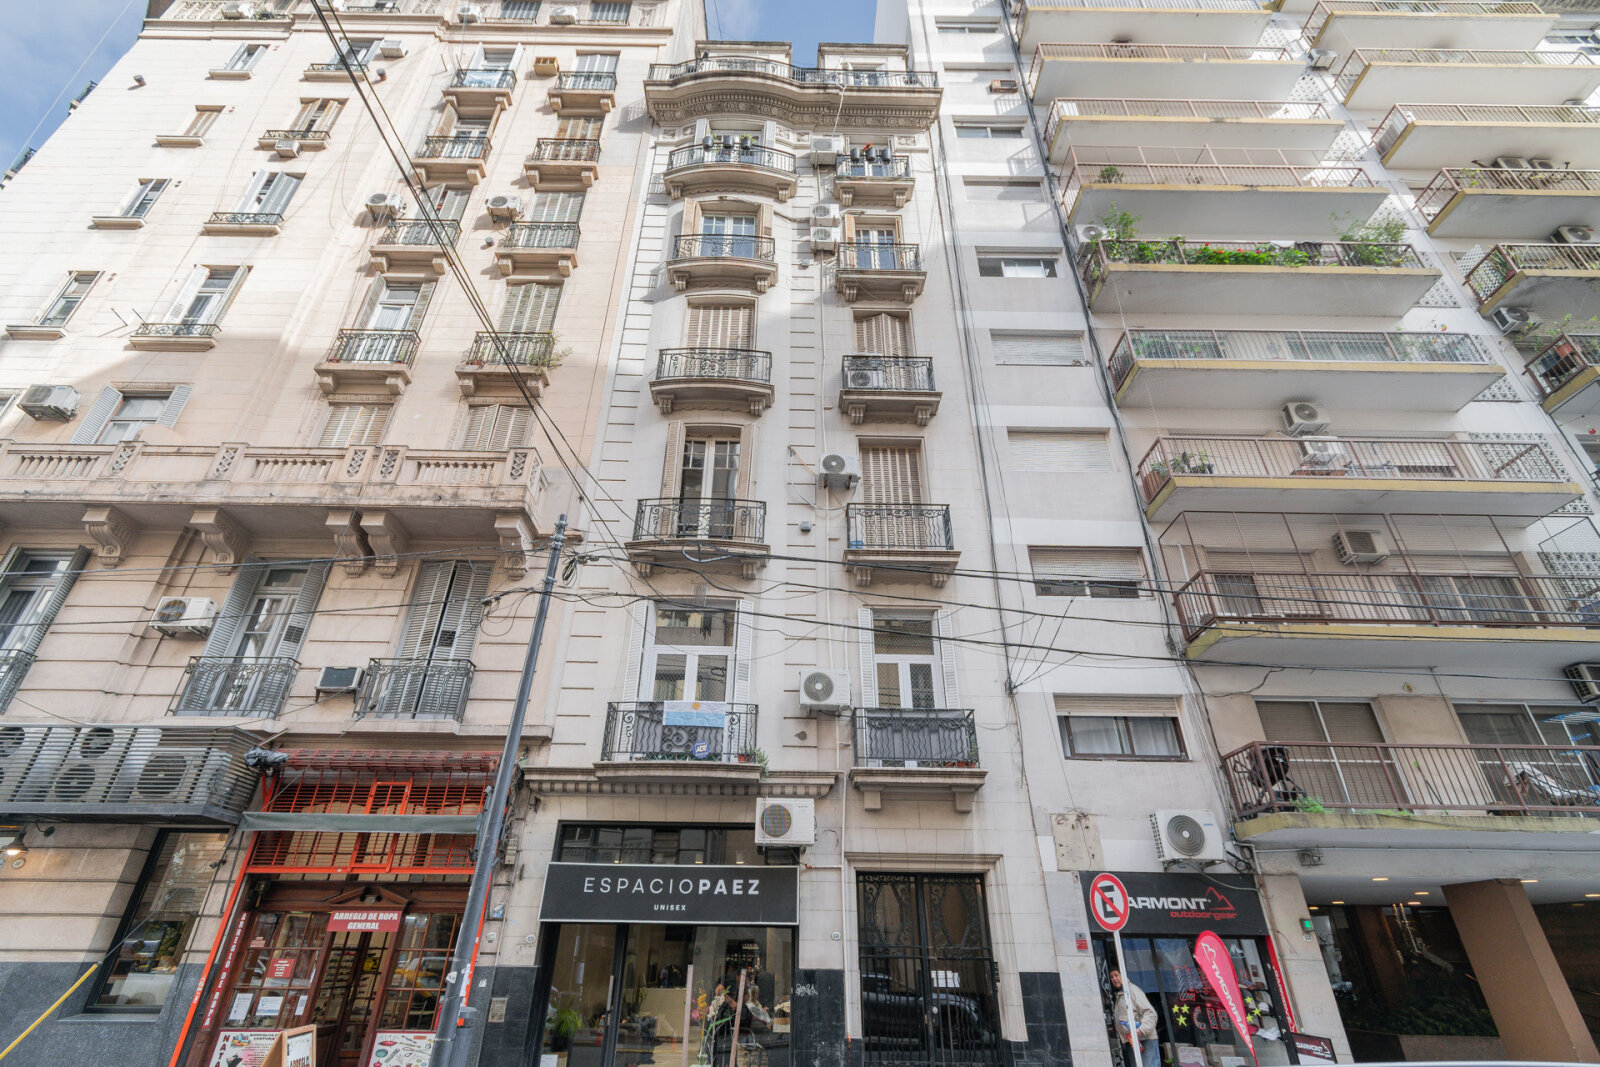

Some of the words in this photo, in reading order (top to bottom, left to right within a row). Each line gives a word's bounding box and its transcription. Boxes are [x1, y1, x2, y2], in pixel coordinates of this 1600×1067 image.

[1128, 897, 1207, 910] ARMONT
[333, 912, 367, 920] ARREGLO
[367, 912, 378, 920] DE
[379, 912, 398, 920] ROPA
[347, 922, 379, 930] GENERAL
[225, 912, 247, 969] ARREGLO
[217, 971, 227, 989] DE
[203, 991, 220, 1026] ROPA
